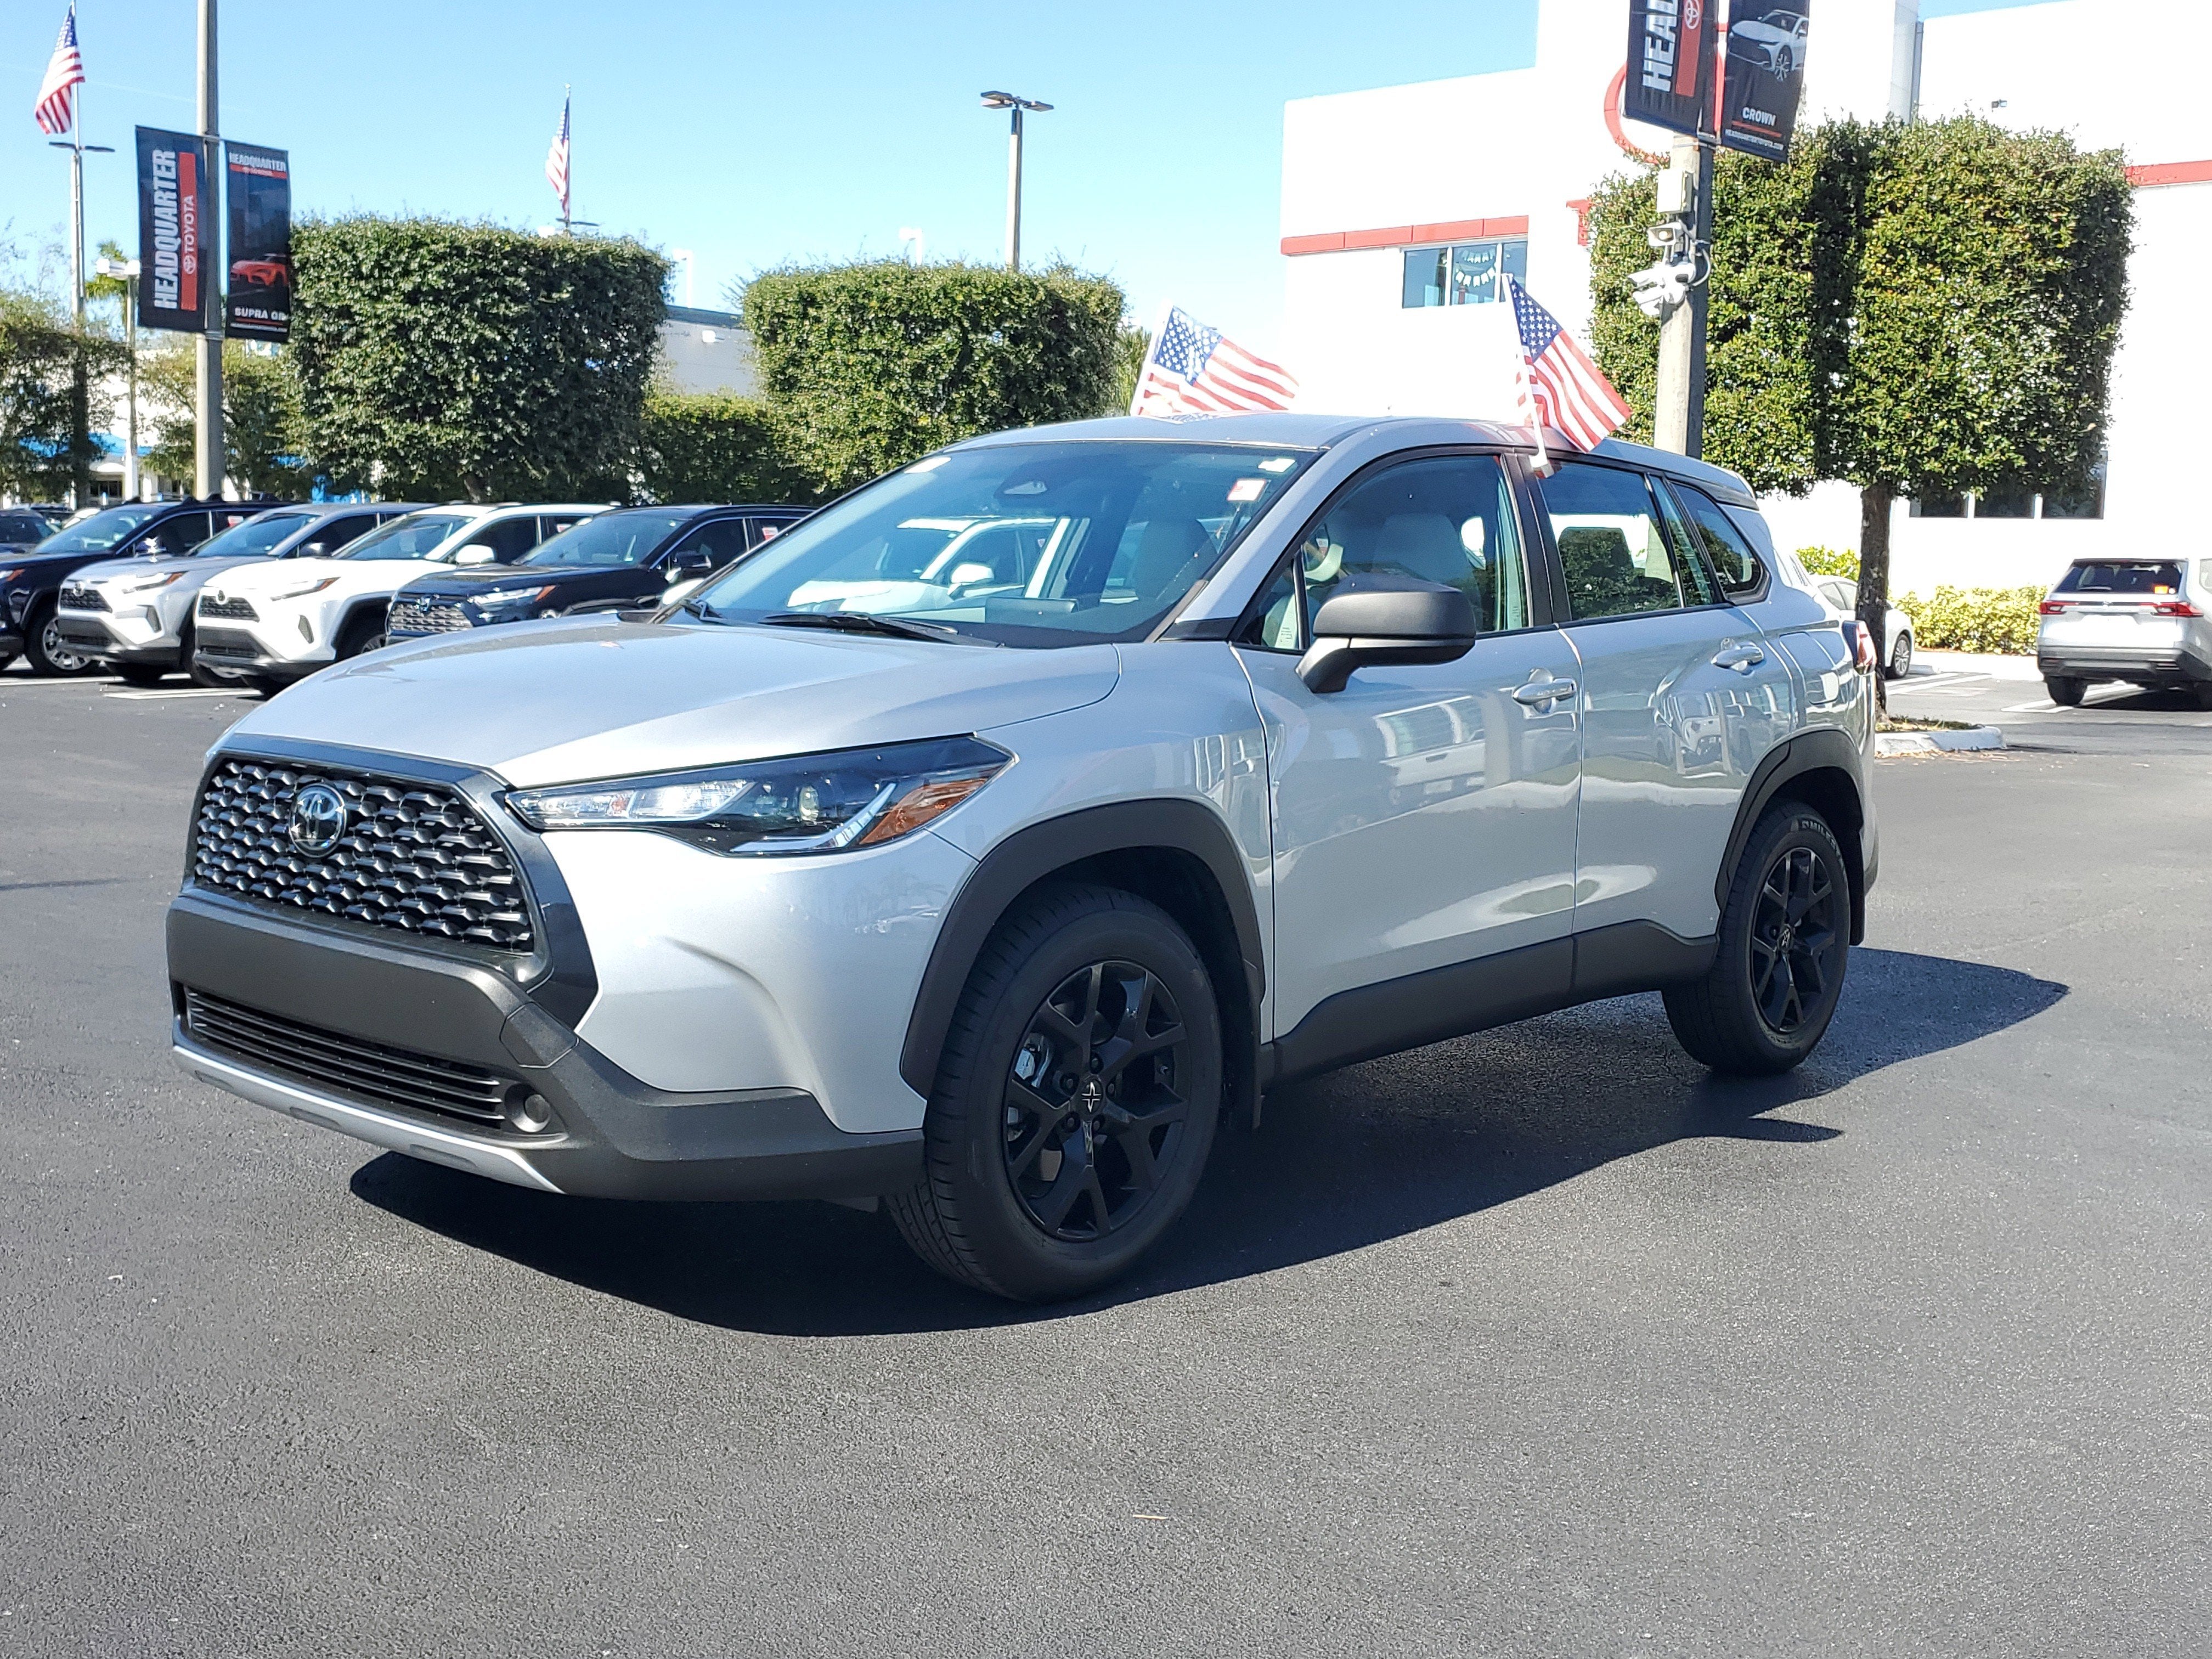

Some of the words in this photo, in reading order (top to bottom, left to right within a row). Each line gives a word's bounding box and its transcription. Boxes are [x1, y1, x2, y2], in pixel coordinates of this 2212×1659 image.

[1742, 106, 1776, 126] CROWN
[152, 149, 181, 309] HEADQUARTER
[183, 195, 195, 254] TOYOTA
[234, 307, 268, 319] SUPRA
